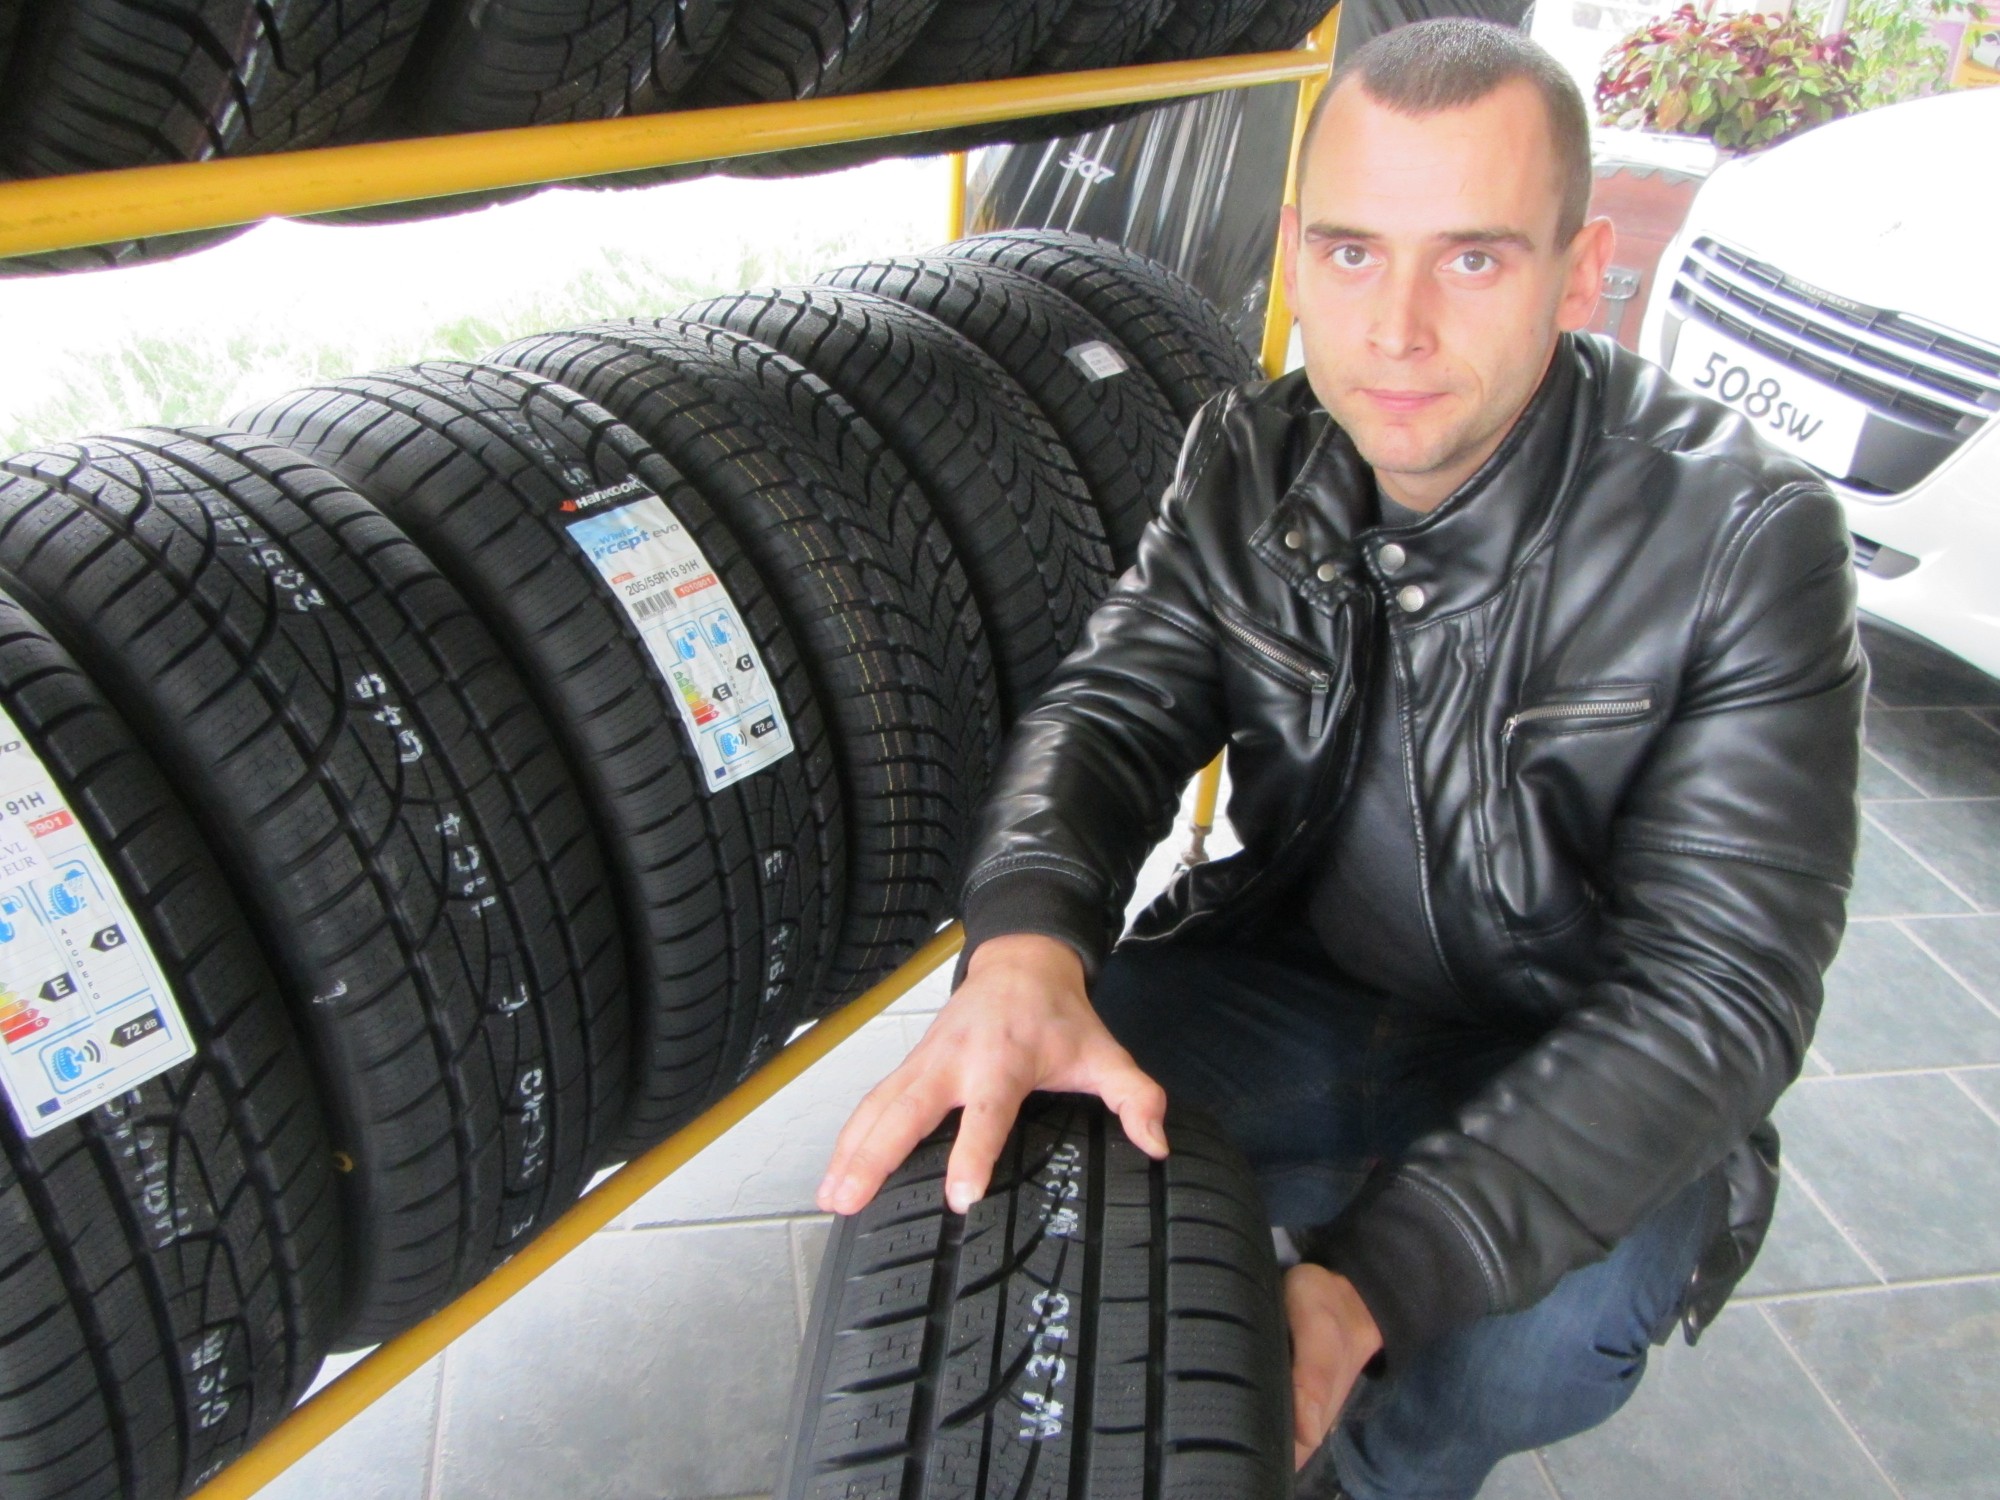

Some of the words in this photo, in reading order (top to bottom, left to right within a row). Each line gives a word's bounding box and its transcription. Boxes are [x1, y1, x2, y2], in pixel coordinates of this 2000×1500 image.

[652, 523, 680, 538] evo
[625, 567, 680, 596] 205/55R16
[678, 559, 700, 575] 91H
[740, 656, 751, 669] C
[718, 685, 729, 698] E
[755, 722, 766, 734] 72
[6, 791, 46, 815] 91H
[4, 856, 37, 877] EUR
[101, 930, 119, 947] C
[50, 978, 70, 997] E
[122, 1023, 143, 1040] 72
[143, 1017, 158, 1031] dB
[1019, 1289, 1071, 1439] W310
